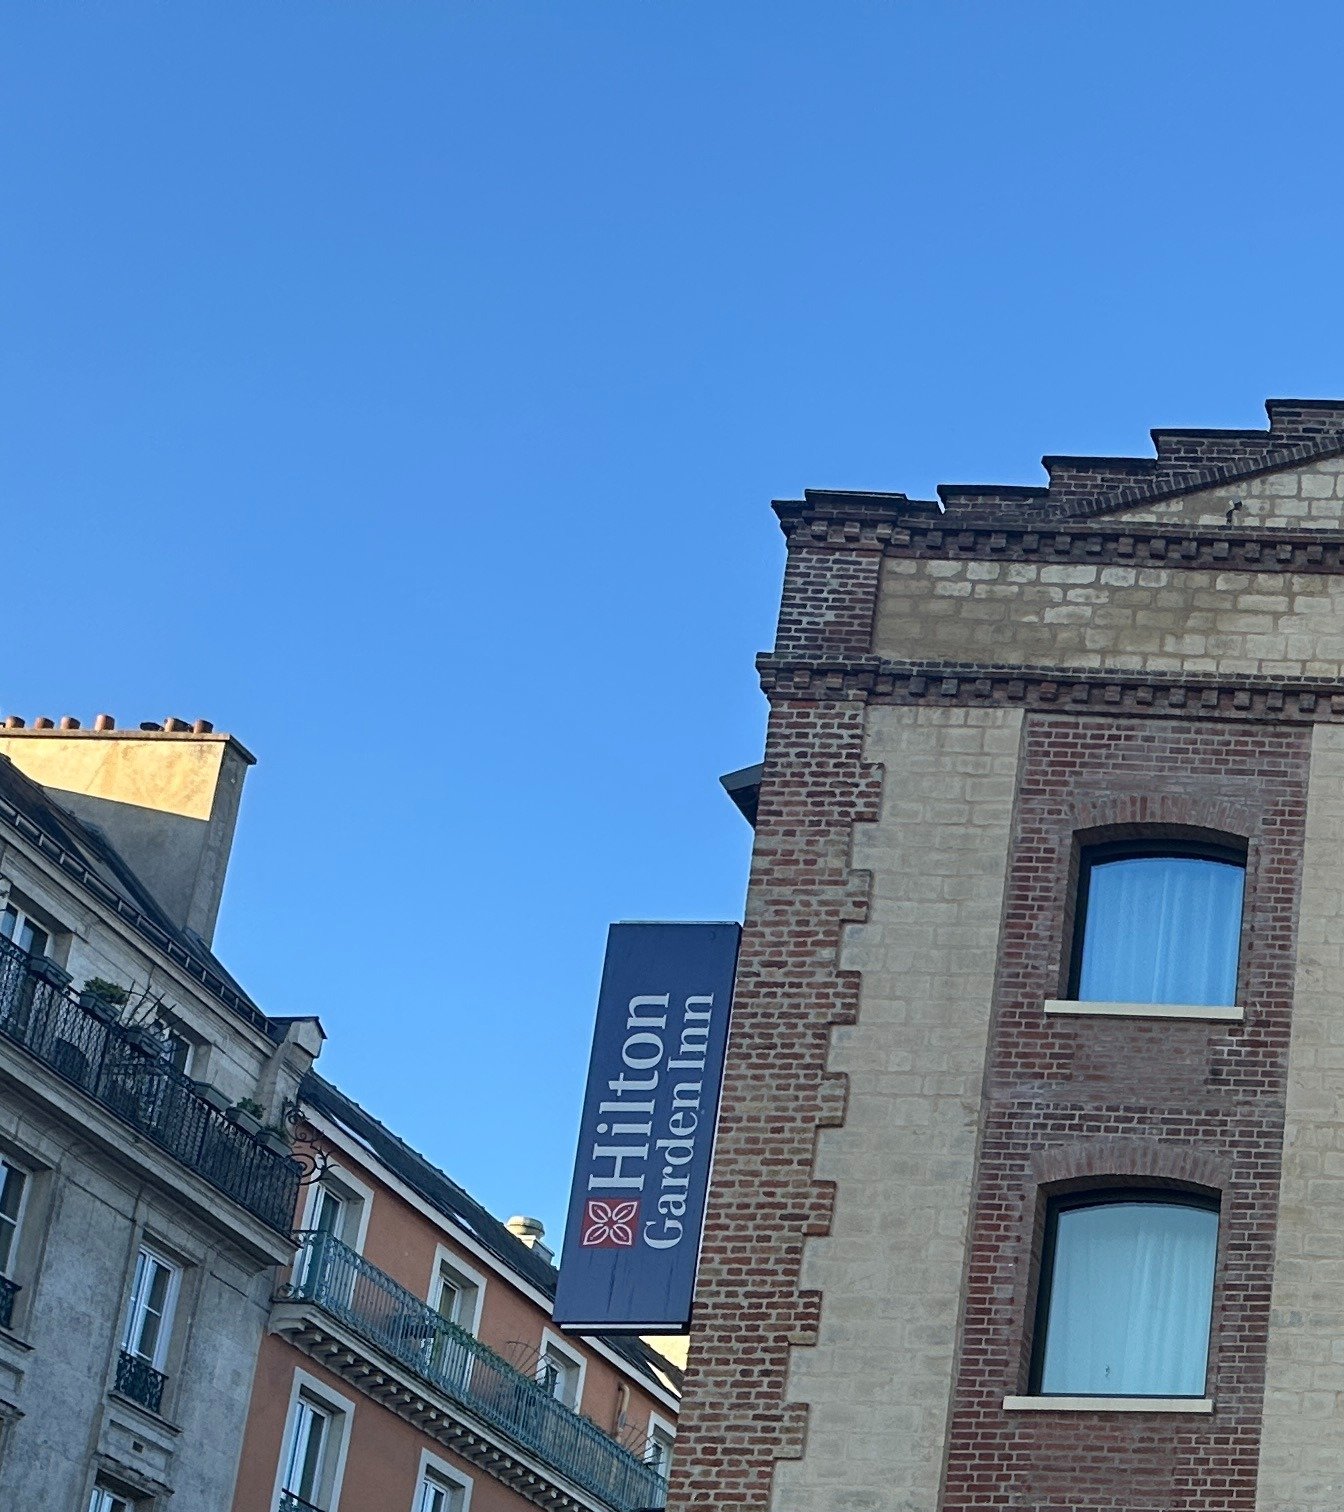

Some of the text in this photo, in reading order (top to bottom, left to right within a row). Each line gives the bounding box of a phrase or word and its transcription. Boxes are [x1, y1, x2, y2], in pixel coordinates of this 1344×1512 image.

[587, 992, 670, 1193] Hilton
[643, 991, 715, 1250] Garden Inn
